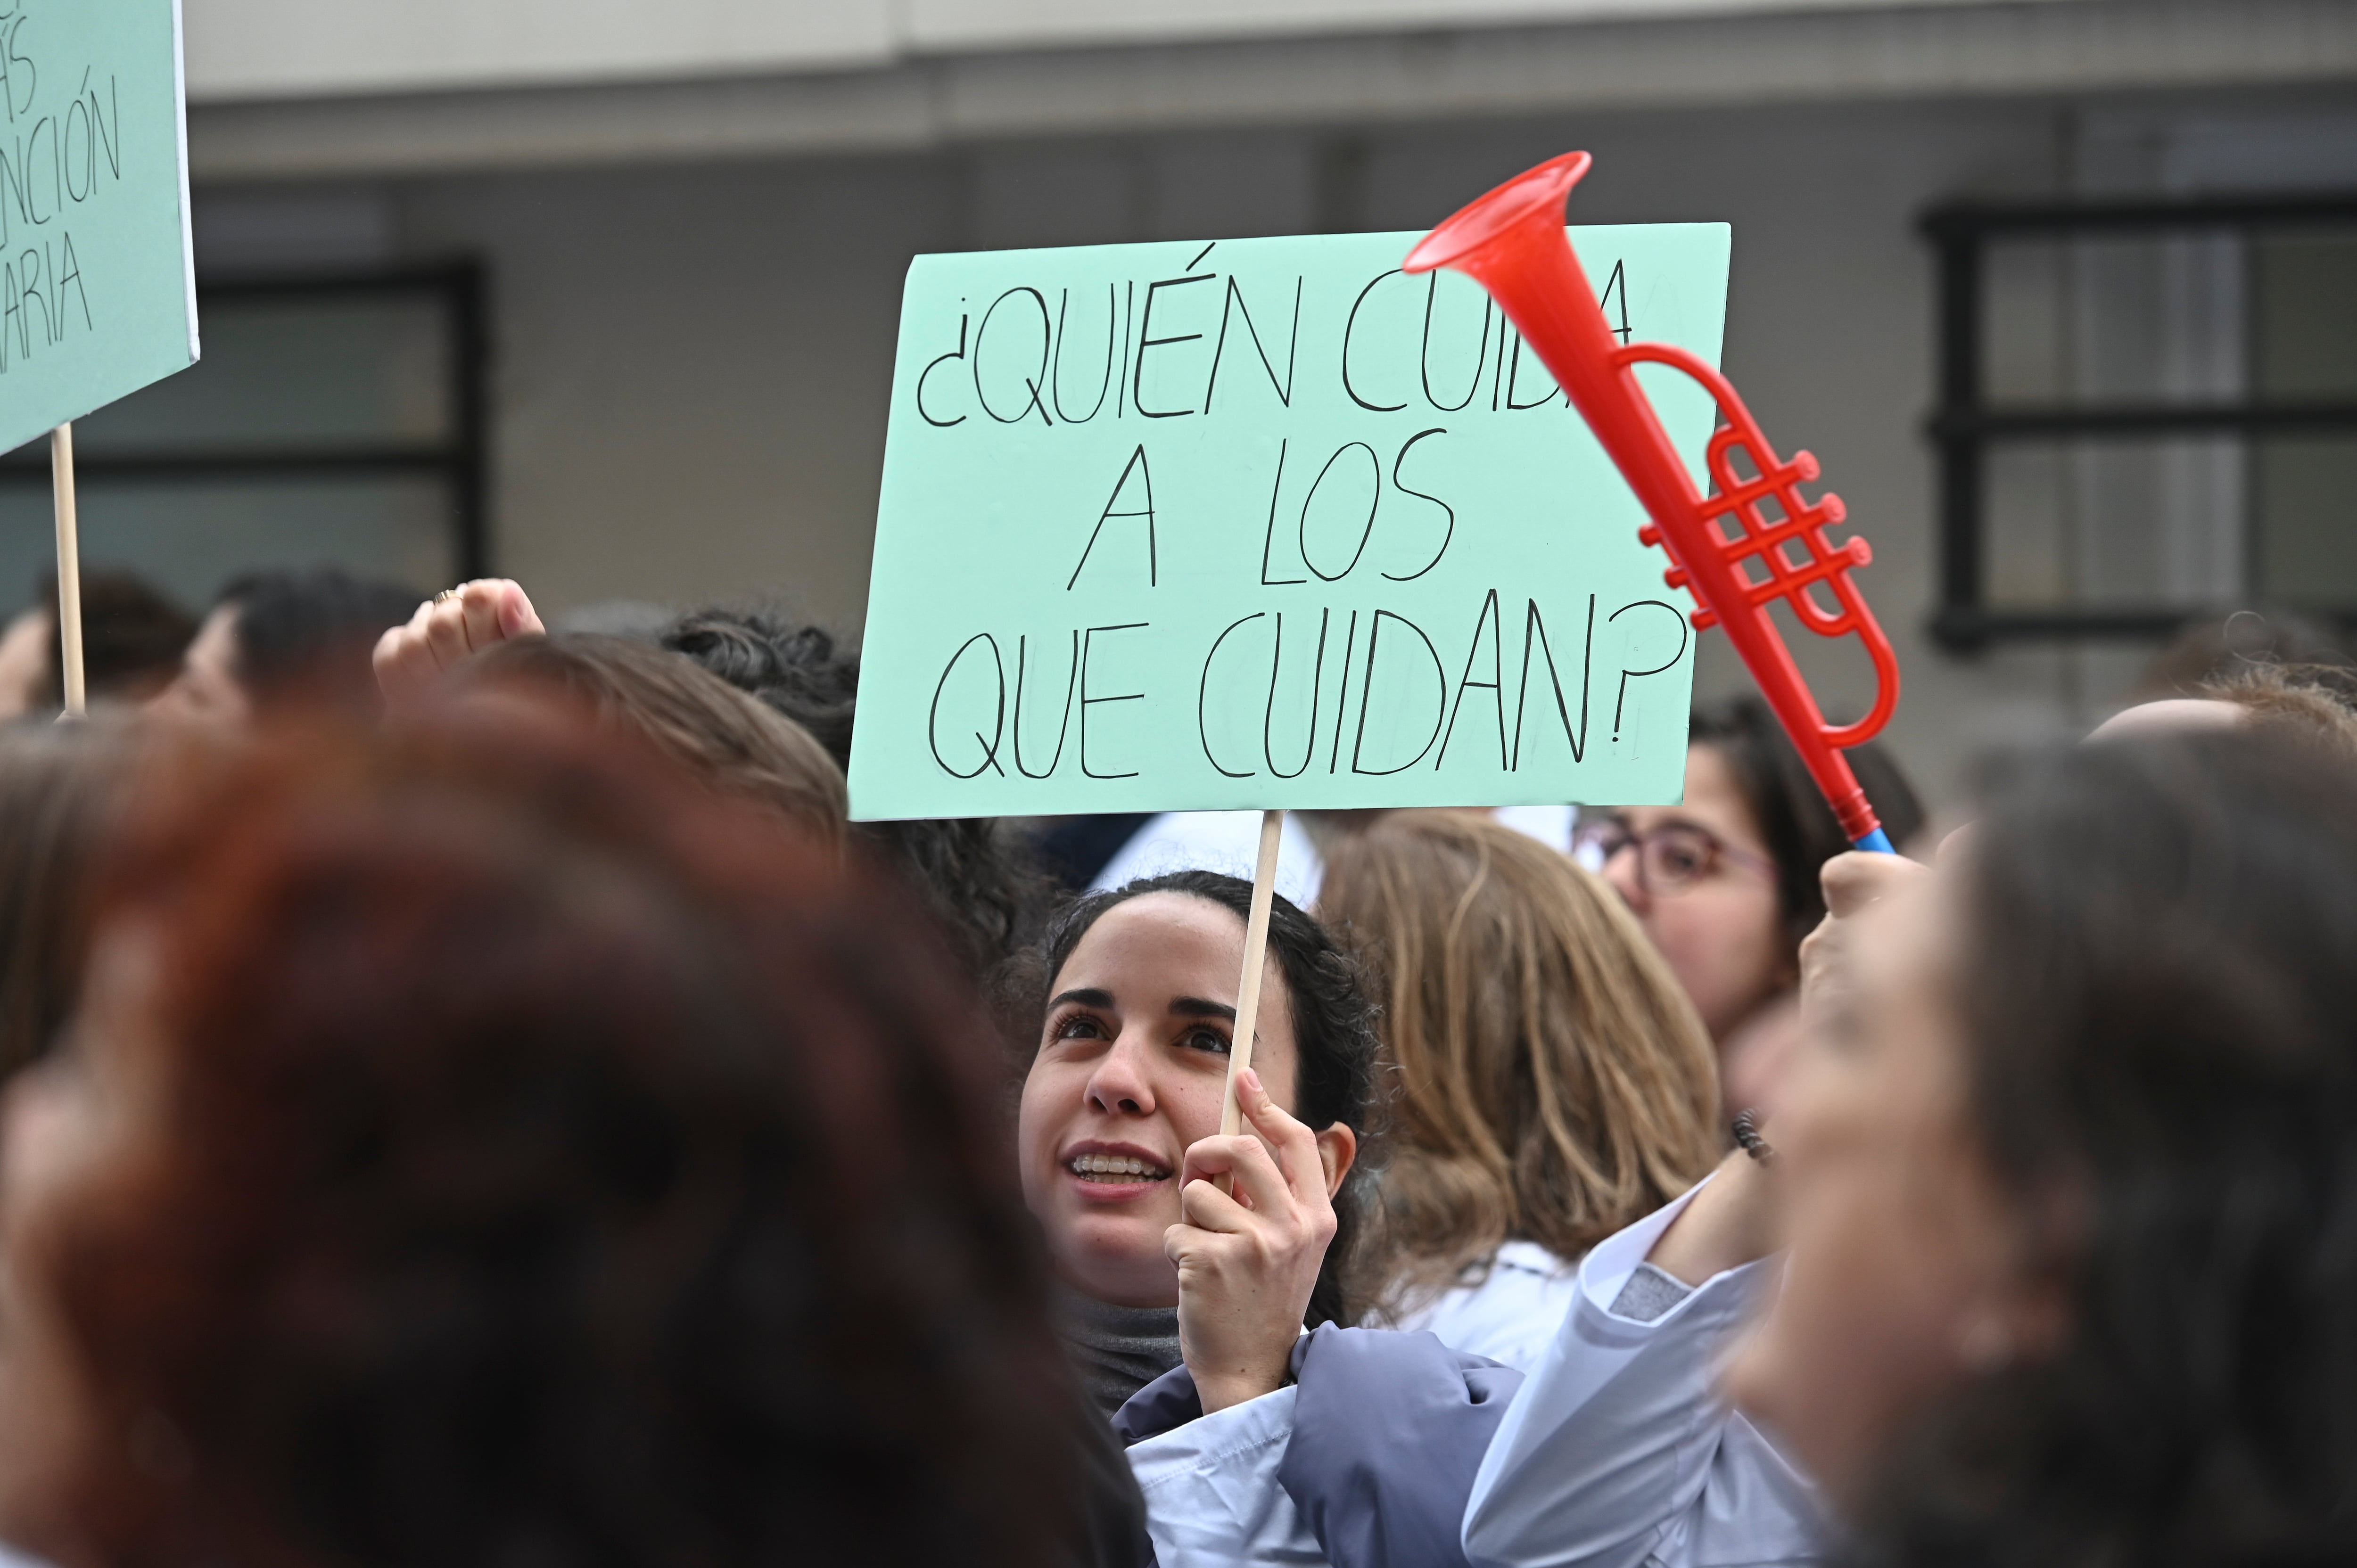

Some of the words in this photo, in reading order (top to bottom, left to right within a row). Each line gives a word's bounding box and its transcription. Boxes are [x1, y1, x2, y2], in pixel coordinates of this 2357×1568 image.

[0, 65, 120, 251] NCIÓN
[0, 231, 92, 373] ARIA
[917, 242, 1302, 427] ¿QUIÉN
[1066, 443, 1156, 591] A
[1261, 428, 1454, 586] LOS
[929, 622, 1150, 780] QUE
[1199, 588, 1687, 779] CUIDAN?
